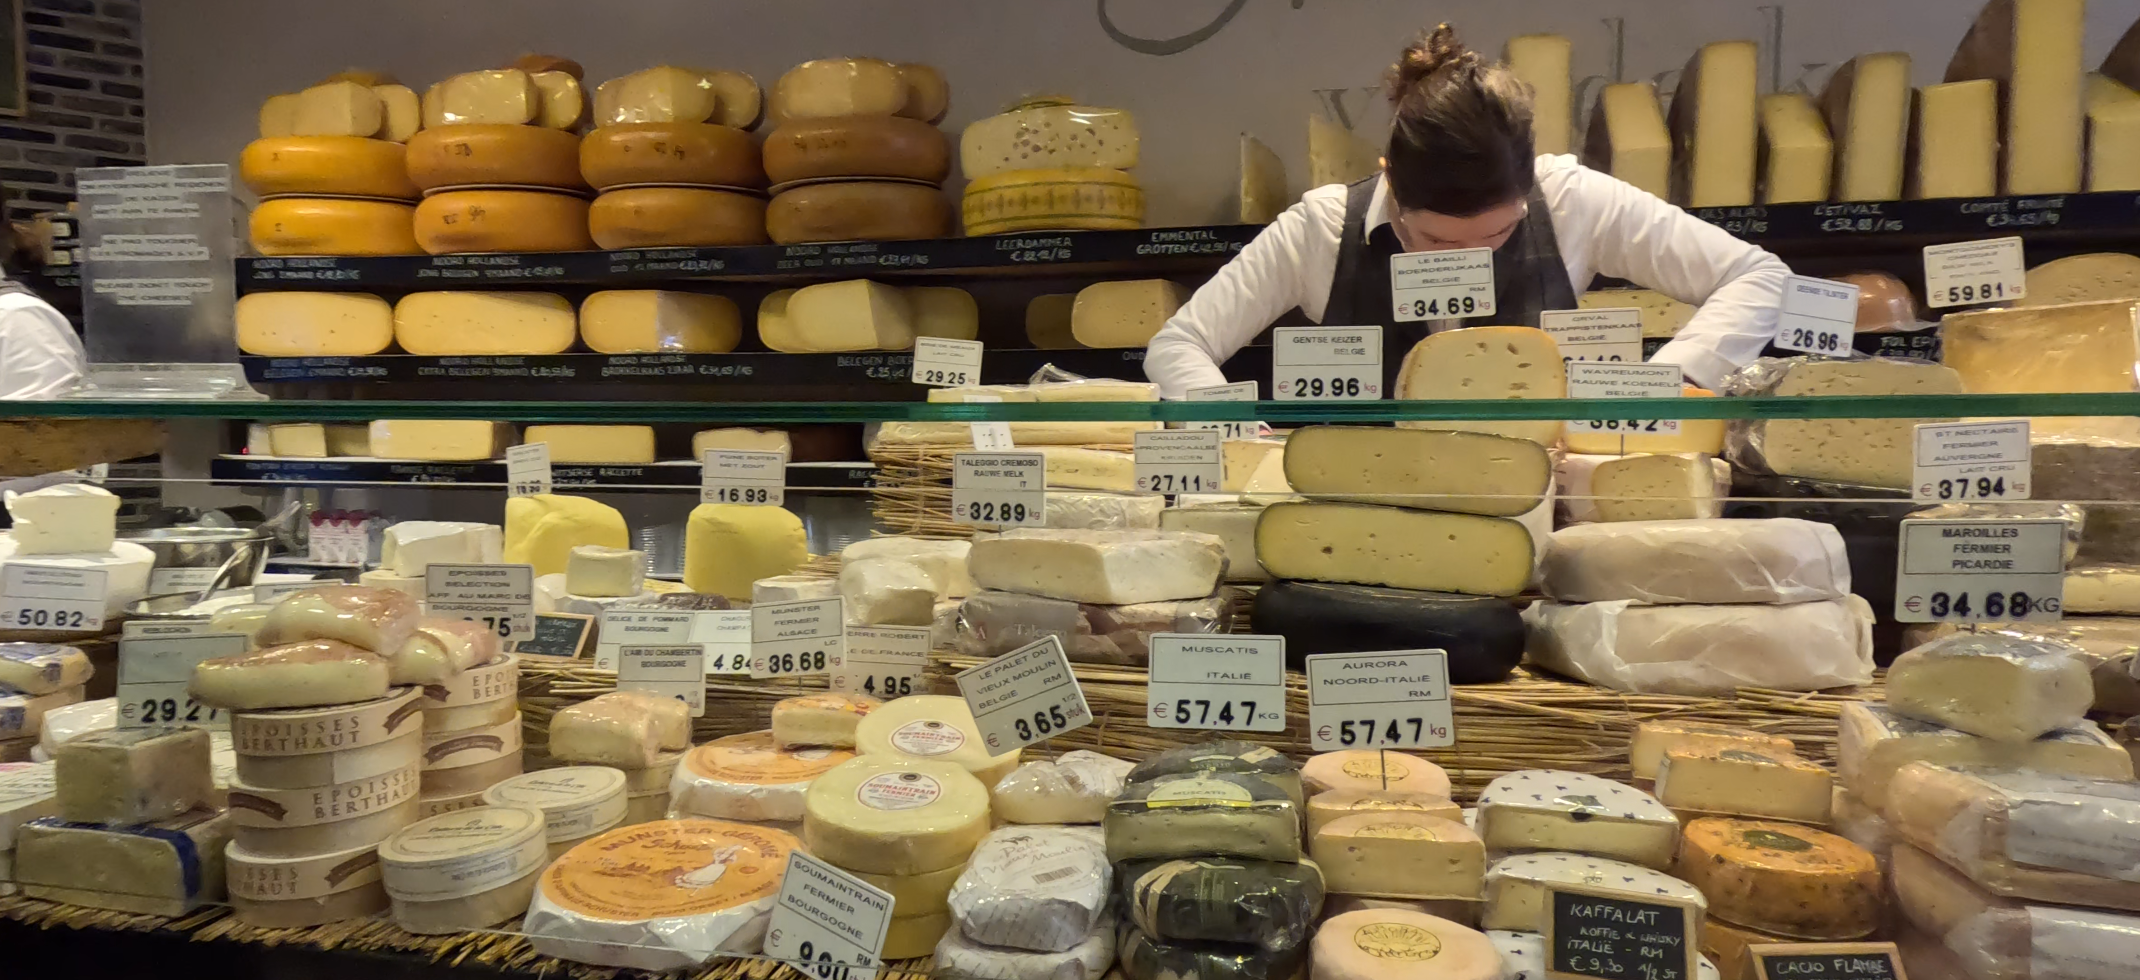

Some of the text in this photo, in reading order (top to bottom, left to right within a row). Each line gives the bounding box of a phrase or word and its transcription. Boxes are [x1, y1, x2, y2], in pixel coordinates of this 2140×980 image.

[1150, 230, 1218, 242] EMMENTAL
[1136, 243, 1189, 255] GROTTEN
[1934, 290, 1944, 301] €
[1948, 281, 2004, 303] 59.81
[1398, 296, 1492, 317] € 34.69 kg
[1292, 336, 1364, 344] GENTSE KEIZER
[1781, 329, 1790, 341] €
[1792, 328, 1839, 351] 26.96
[925, 369, 967, 385] 29.25
[1581, 368, 1672, 376] WAVREUMONT
[1278, 377, 1378, 397] € 29.96 kg
[1662, 419, 1678, 430] kg
[961, 459, 1039, 467] TALEGGIO CREMOSO
[1136, 475, 1218, 492] € 27.11 kg
[1920, 483, 1934, 497] €
[1938, 476, 2006, 500] 37.94
[704, 489, 714, 500] €
[717, 488, 767, 503] 16.93
[956, 502, 1041, 522] € 32.89 kg
[1942, 528, 2019, 538] MAROILLES
[1952, 559, 2014, 570] PICARDIE
[771, 605, 821, 615] MUNSTER
[1904, 591, 2060, 619] € 34.68 KG
[17, 608, 84, 628] 50.82
[776, 628, 818, 638] ALSACE
[880, 632, 927, 640] ROBERT
[1181, 645, 1259, 655] MUSCATIS
[597, 658, 609, 669] €
[753, 650, 842, 674] € 36.68 kg
[978, 648, 1050, 681] LE PALET DU
[1342, 660, 1409, 669] AURORA
[834, 674, 912, 696] € 4.95
[976, 659, 1057, 695] VIEUX MOULIN
[1042, 672, 1063, 686] RM
[122, 702, 138, 719] €
[1153, 698, 1280, 726] € 57.47 KG
[986, 692, 1086, 748] € 1/2 stuk
[1316, 717, 1448, 746] € 57.47 kg
[793, 860, 885, 912] SOUMAINTRAIN
[803, 883, 856, 916] FERMIER
[787, 894, 864, 941] BOURGOGNE
[1569, 903, 1661, 927] KAFFALAT
[769, 928, 784, 948] €
[1579, 925, 1621, 940] KOFFIE
[856, 953, 872, 967] RM
[1639, 946, 1664, 960] RM
[1569, 955, 1587, 972] €
[1776, 959, 1826, 976] CACIO
